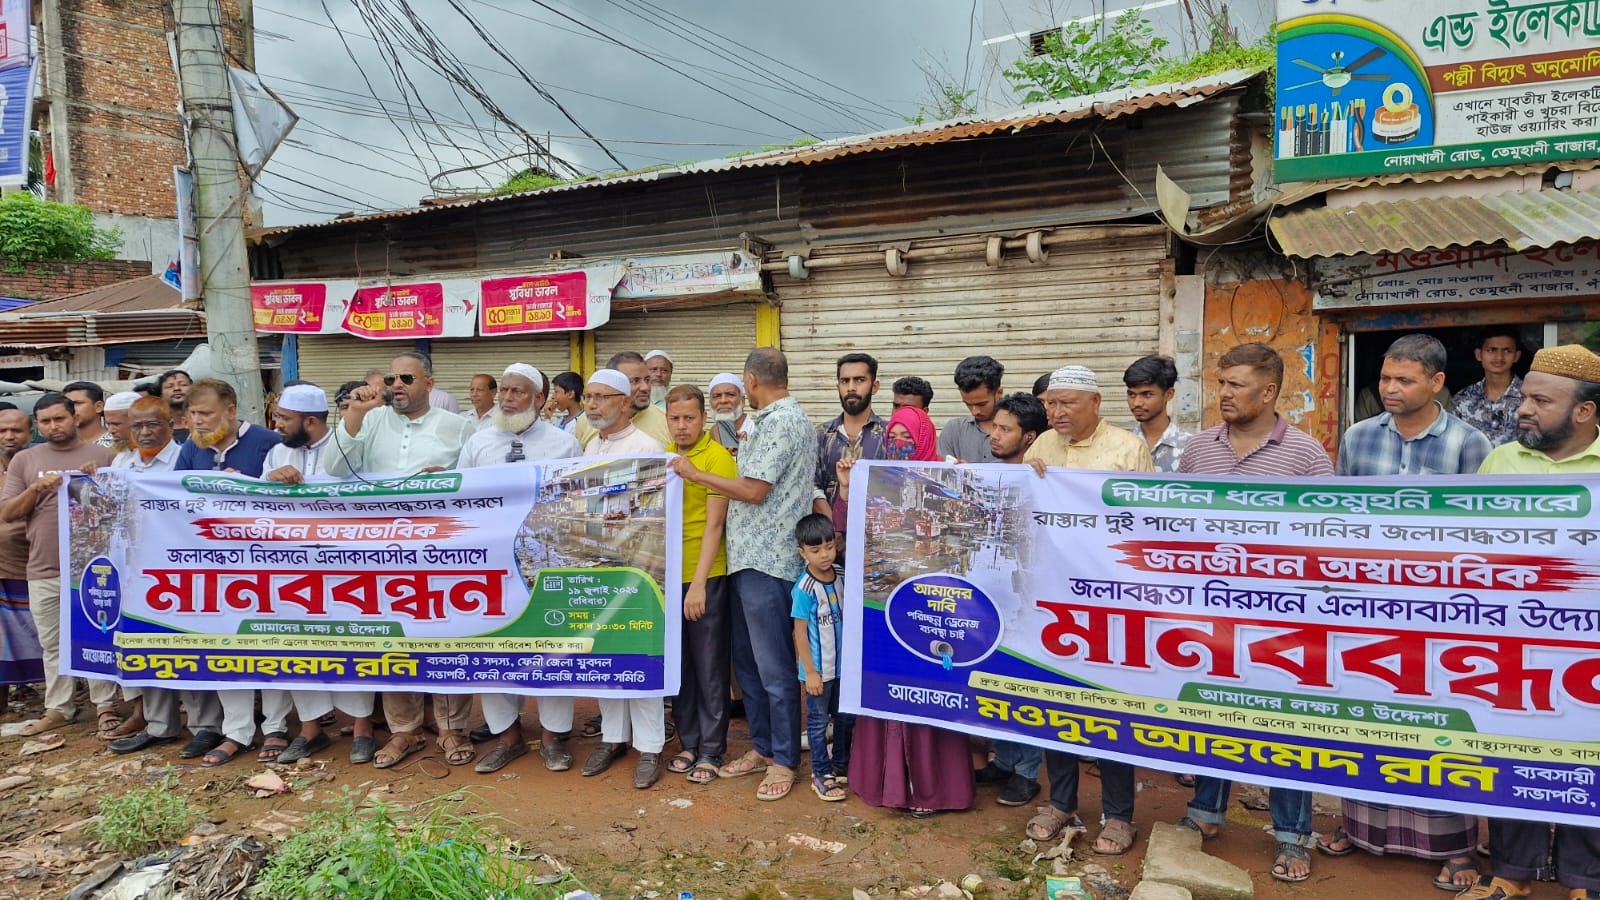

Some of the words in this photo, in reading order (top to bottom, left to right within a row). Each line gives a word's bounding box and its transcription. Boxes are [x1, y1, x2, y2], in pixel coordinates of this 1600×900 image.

[1422, 12, 1479, 53] এন্ড
[1443, 63, 1476, 87] পল্লী
[1481, 61, 1526, 84] বিদ্যুৎ
[1452, 99, 1494, 113] এখানে
[1498, 93, 1545, 108] যাবতীয়
[1465, 108, 1519, 125] পাইকারী
[1523, 109, 1534, 119] ও
[1540, 103, 1571, 119] খুচরা
[1476, 123, 1511, 137] হাউজ
[1571, 116, 1598, 128] করা
[1384, 149, 1446, 168] নোয়াখালী
[1450, 149, 1485, 163] রোড,
[1491, 140, 1550, 160] তেমুহানী
[1355, 287, 1420, 301] নোয়াখালী
[1469, 282, 1523, 296] তেমুহনী
[556, 301, 566, 320] ২
[140, 499, 179, 512] রাস্তার
[185, 496, 206, 514] দুই
[212, 499, 245, 512] পাশে
[251, 500, 295, 512] ময়লা
[301, 499, 346, 512] পানির
[352, 499, 446, 512] জলাবদ্ধতার
[452, 497, 503, 509] কারণে
[1111, 482, 1215, 505] দীর্ঘদিন
[1225, 488, 1286, 507] ধরে
[1298, 488, 1432, 514] তেমুহনি
[1442, 493, 1580, 513] বাজারে
[209, 517, 310, 540] জনজীবন
[316, 518, 439, 540] অস্বাভাবিক
[1032, 511, 1098, 529] রাস্তার
[1105, 512, 1135, 534] দুই
[1142, 516, 1197, 533] পাশে
[1204, 517, 1281, 536] ময়লা
[1289, 517, 1372, 540] পানির
[1380, 524, 1558, 545] জলাবদ্ধতার
[167, 548, 245, 565] জলাবদ্ধতা
[249, 543, 309, 564] নিরসনে
[314, 543, 418, 565] এলাকাবাসীর
[423, 544, 488, 565] উদ্যোগে
[1141, 543, 1307, 578] জনজীবন
[1318, 554, 1542, 589] অস্বাভাবিক
[566, 574, 594, 584] তারিখ
[142, 568, 509, 620] মানববন্ধন
[568, 587, 580, 595] ১৯
[584, 585, 609, 596] জুলাই
[913, 583, 973, 600] আমাদের
[567, 611, 590, 620] সময়
[927, 597, 957, 613] দাবি
[1069, 577, 1195, 606] জলাবদ্ধতা
[1202, 579, 1307, 614] নিরসনে
[1317, 592, 1509, 627] এলাকাবাসীর
[1518, 598, 1600, 633] উদ্যো
[250, 622, 300, 633] আমাদের
[304, 624, 331, 634] লক্ষ্য
[335, 626, 345, 634] ও
[349, 622, 390, 636] উদ্দেশ্য
[568, 622, 593, 631] সকাল
[944, 616, 980, 629] ড্রেনেজ
[949, 629, 966, 640] চাই
[205, 655, 347, 676] আহমেদ
[353, 652, 419, 677] রনি
[426, 653, 469, 666] ব্যবসায়ী
[472, 657, 480, 665] ও
[517, 654, 543, 667] ফেনী
[546, 657, 573, 667] জেলা
[577, 657, 612, 669] যুবদল
[473, 668, 499, 681] ফেনী
[502, 671, 529, 681] জেলা
[532, 669, 573, 682] সিএনজি
[576, 670, 611, 682] মালিক
[613, 670, 646, 683] সমিতি
[979, 676, 1000, 688] দ্রুত
[1003, 679, 1039, 695] ড্রেনেজ
[1043, 686, 1077, 702] ব্যবস্থা
[1080, 690, 1118, 706] নিশ্চিত
[1123, 698, 1146, 711] করা
[1198, 688, 1282, 710] আমাদের
[1289, 697, 1340, 716] লক্ষ্য
[1347, 704, 1365, 718] ও
[1372, 703, 1448, 727] উদ্দেশ্য
[1178, 705, 1212, 720] ময়লা
[1217, 710, 1247, 724] পানি
[1252, 715, 1295, 729] ড্রেনের
[1300, 721, 1350, 736] মাধ্যমে
[1355, 726, 1421, 743] অপসারণ
[888, 683, 969, 710] আয়োজনে:
[975, 695, 1121, 745] মওদুদ
[1130, 721, 1363, 776] আহমেদ
[1375, 752, 1500, 792] রনি
[1550, 746, 1563, 757] ও
[1569, 748, 1600, 761] বাস
[1512, 765, 1596, 785] ব্যবসায়ী
[1512, 785, 1596, 808] সভাপতি,
